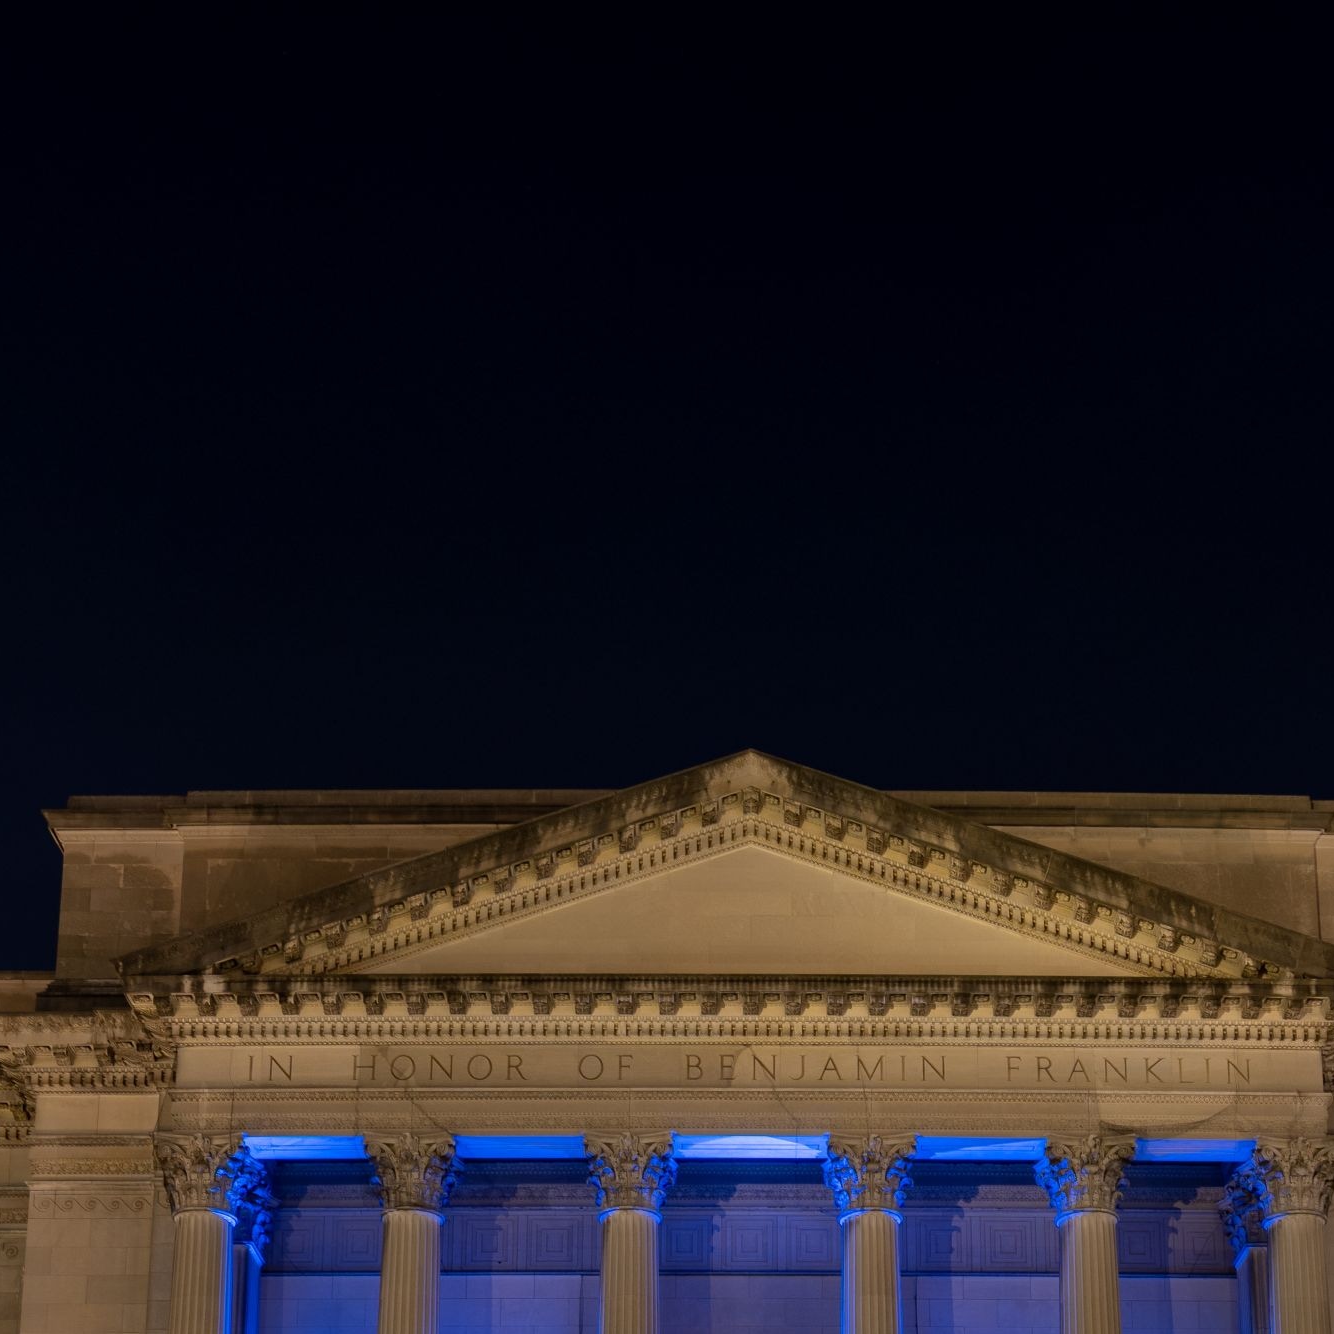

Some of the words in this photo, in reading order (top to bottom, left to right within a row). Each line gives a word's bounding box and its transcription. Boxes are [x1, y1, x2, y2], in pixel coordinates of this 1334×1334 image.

[246, 1054, 295, 1082] IN
[351, 1054, 529, 1082] HONOR
[577, 1054, 635, 1081] OF
[686, 1054, 948, 1083] BENJAMIN
[1005, 1056, 1253, 1084] FRANKLIN
